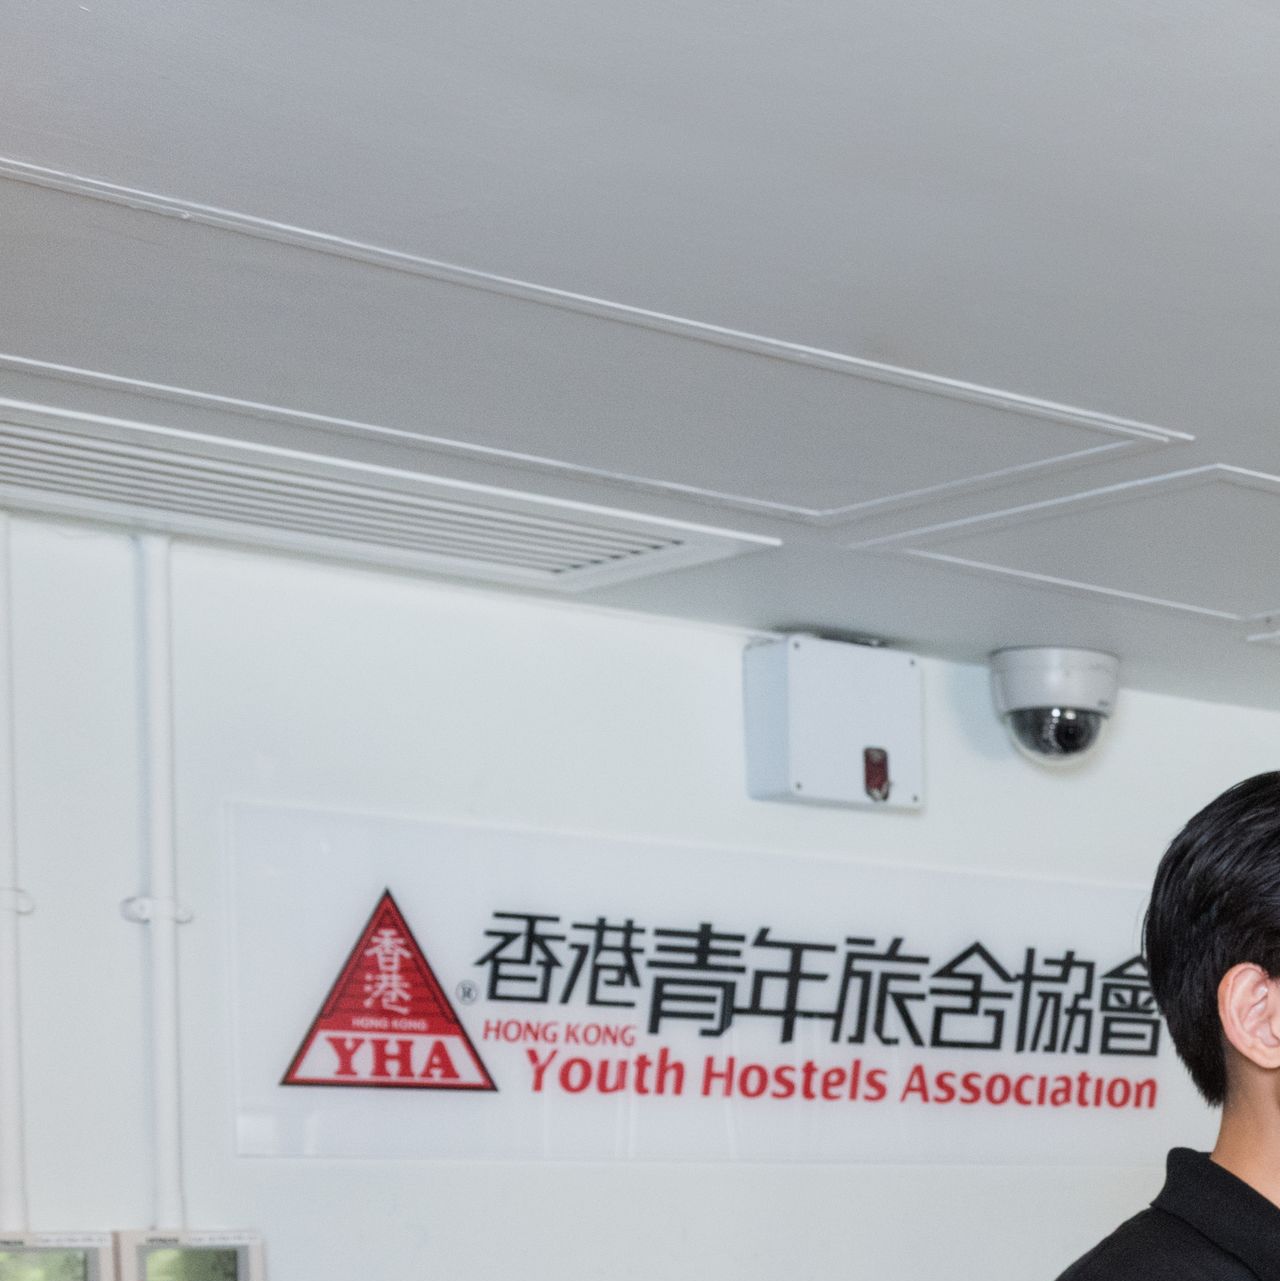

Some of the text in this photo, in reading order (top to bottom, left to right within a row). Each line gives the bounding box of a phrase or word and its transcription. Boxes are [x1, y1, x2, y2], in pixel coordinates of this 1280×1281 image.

[474, 910, 1160, 1057] 香港青年旅舍協會
[325, 1036, 460, 1079] YHA
[483, 1019, 637, 1047] HONG KONG
[527, 1047, 1158, 1110] Youth Hostels Association
